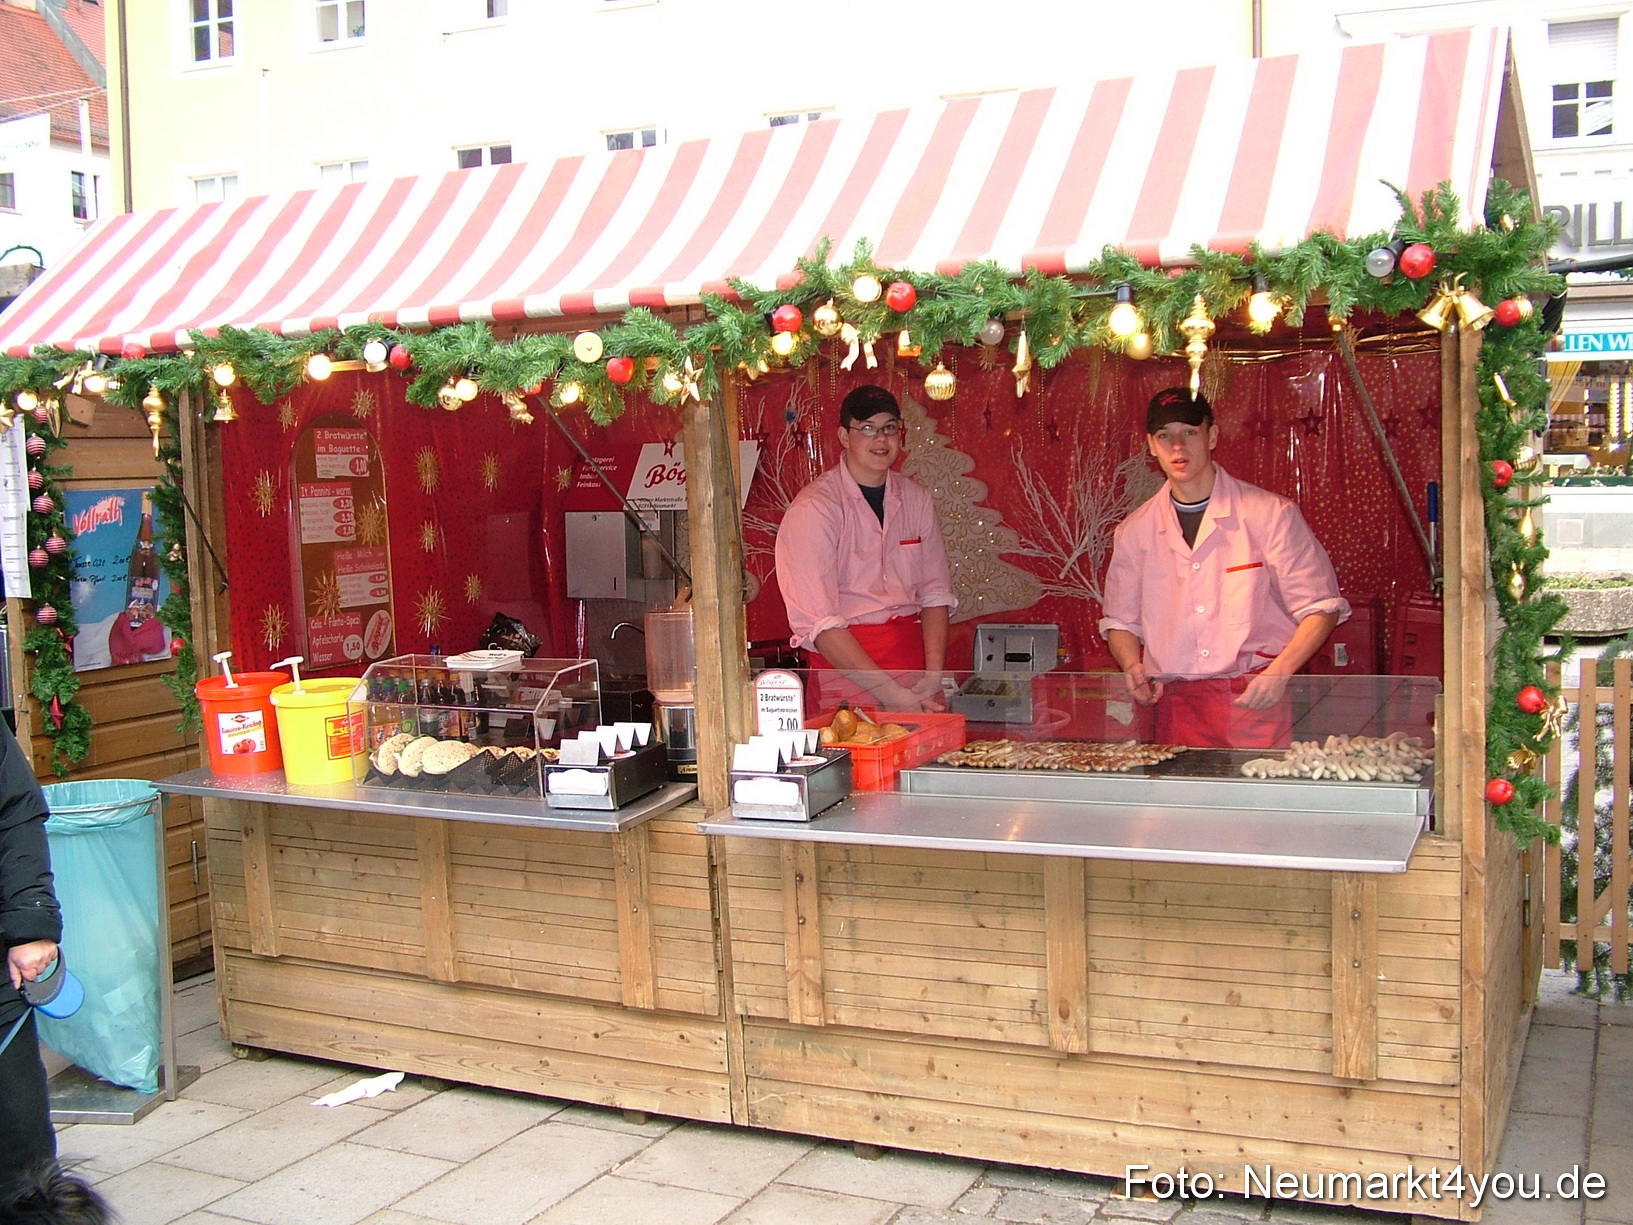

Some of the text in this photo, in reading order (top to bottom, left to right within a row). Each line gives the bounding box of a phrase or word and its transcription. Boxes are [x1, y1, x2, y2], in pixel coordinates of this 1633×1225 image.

[1563, 335, 1603, 351] IEN
[316, 430, 322, 440] 2
[317, 443, 360, 455] im Baguette
[72, 496, 123, 536] Vollrath
[346, 641, 360, 653] 1,50
[313, 652, 333, 662] Wasser
[760, 693, 764, 702] 2
